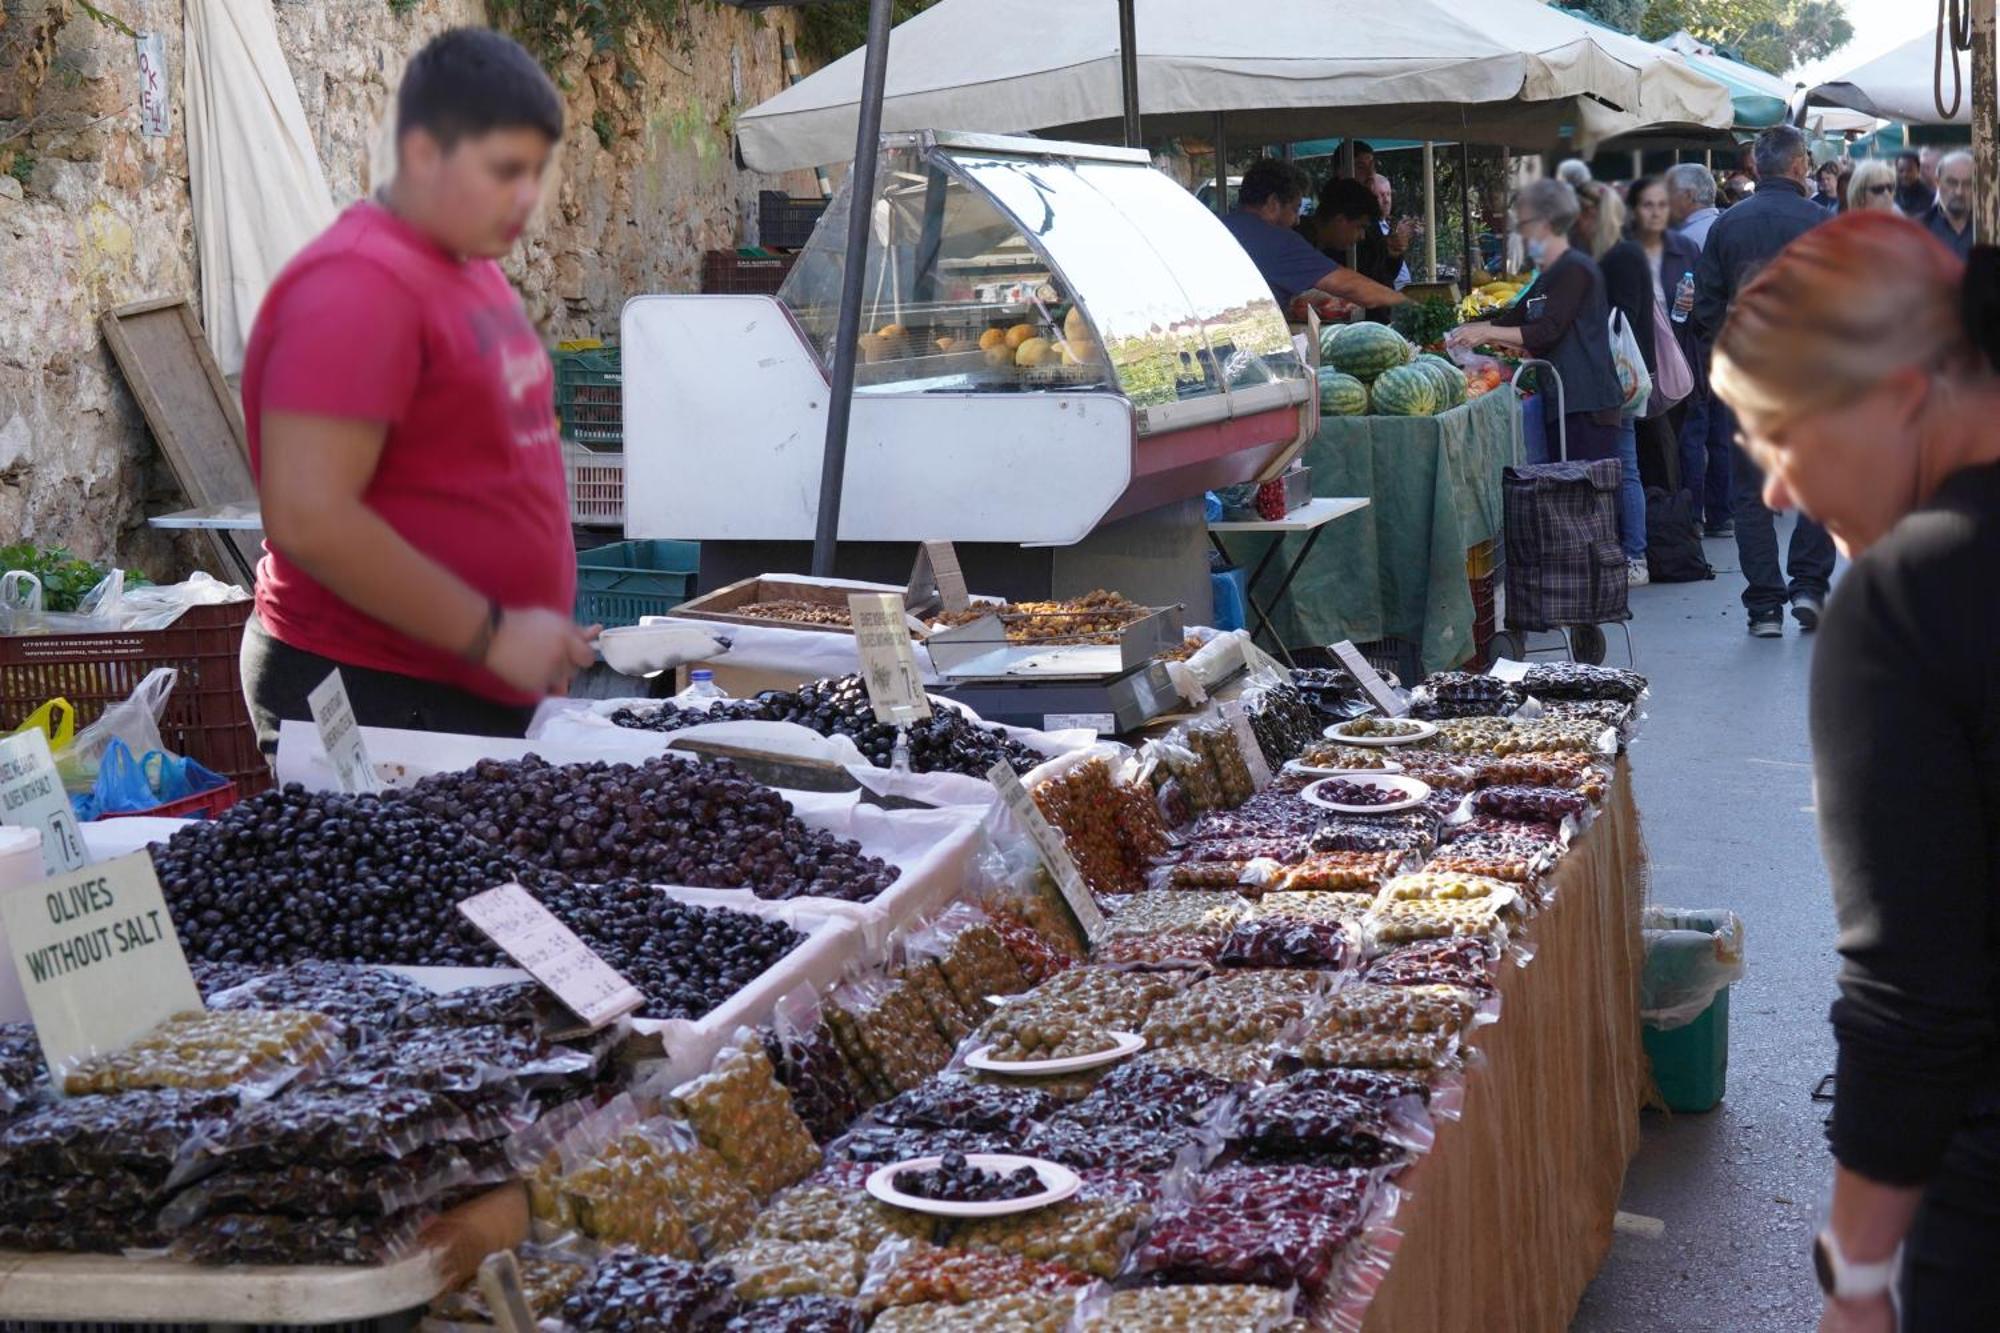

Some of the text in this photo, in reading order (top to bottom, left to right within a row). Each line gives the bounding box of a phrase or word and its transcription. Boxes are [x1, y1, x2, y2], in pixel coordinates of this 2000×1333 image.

[46, 877, 114, 924] OLIVES
[25, 910, 163, 983] WITHOUT SALT
